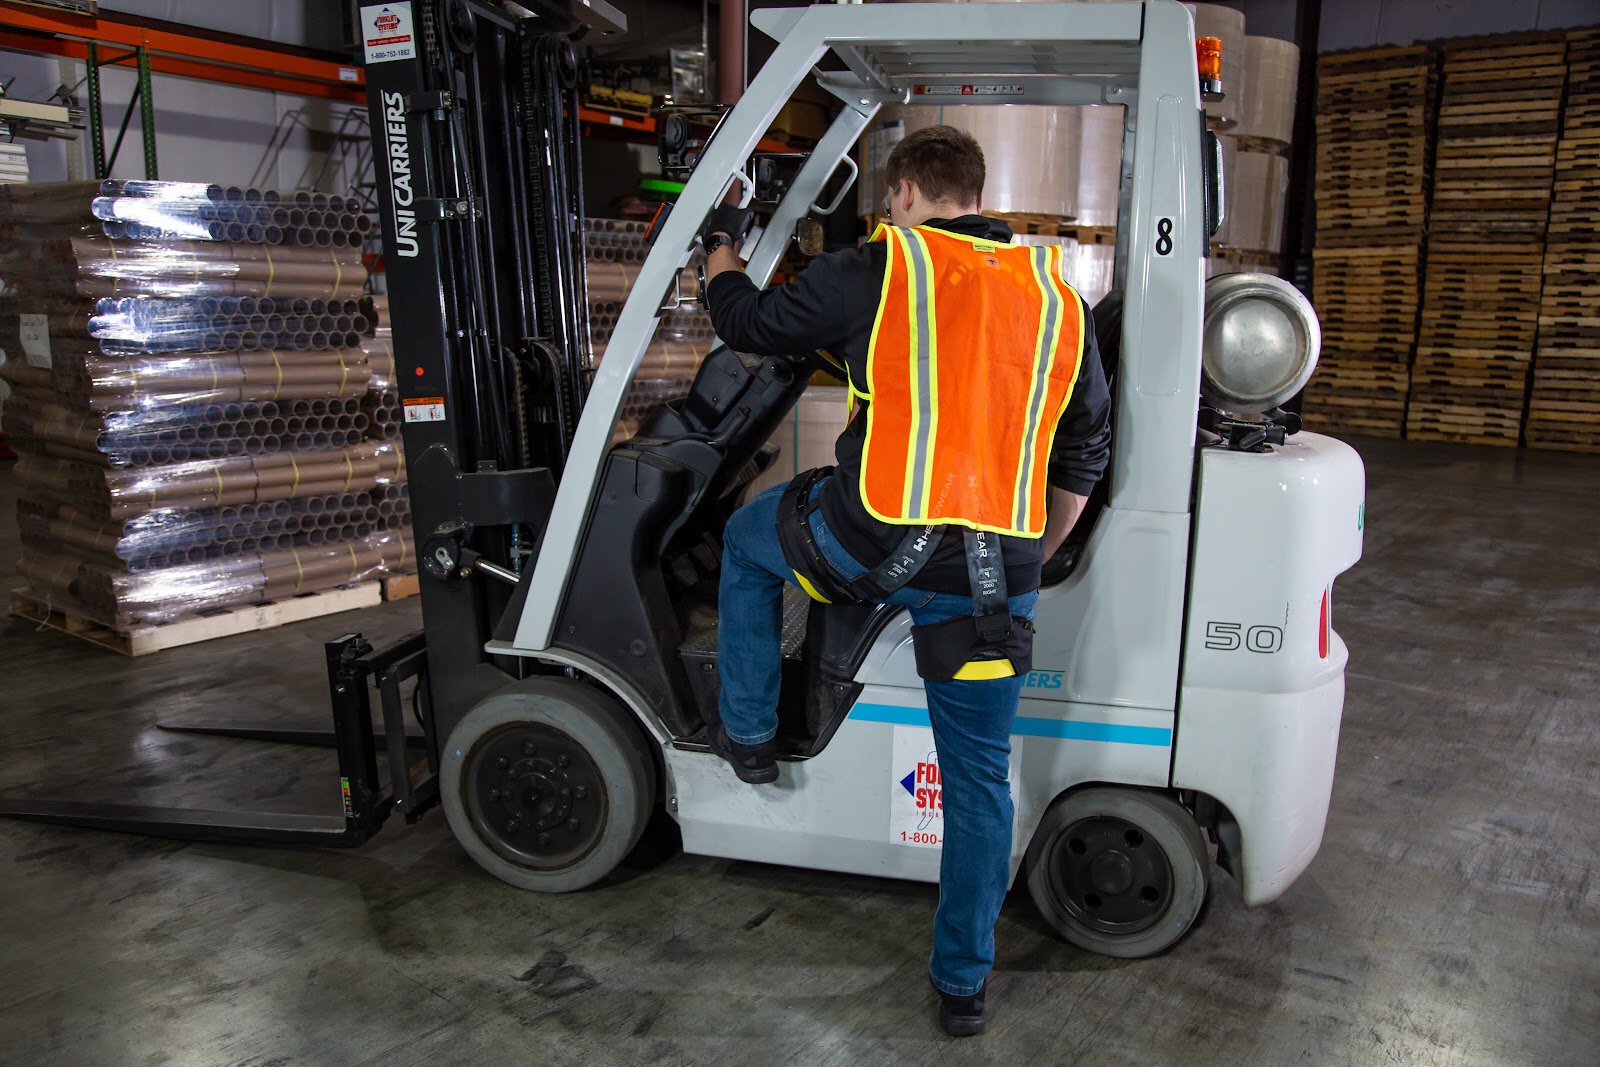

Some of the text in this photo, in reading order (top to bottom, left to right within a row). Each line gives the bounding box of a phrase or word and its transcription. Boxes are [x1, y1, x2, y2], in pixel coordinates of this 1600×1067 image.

[378, 23, 398, 31] SYSTEMS
[382, 90, 419, 258] UNICARRIERS
[1156, 217, 1173, 256] 8
[922, 473, 956, 540] HEOWEAR
[1205, 621, 1283, 654] 50
